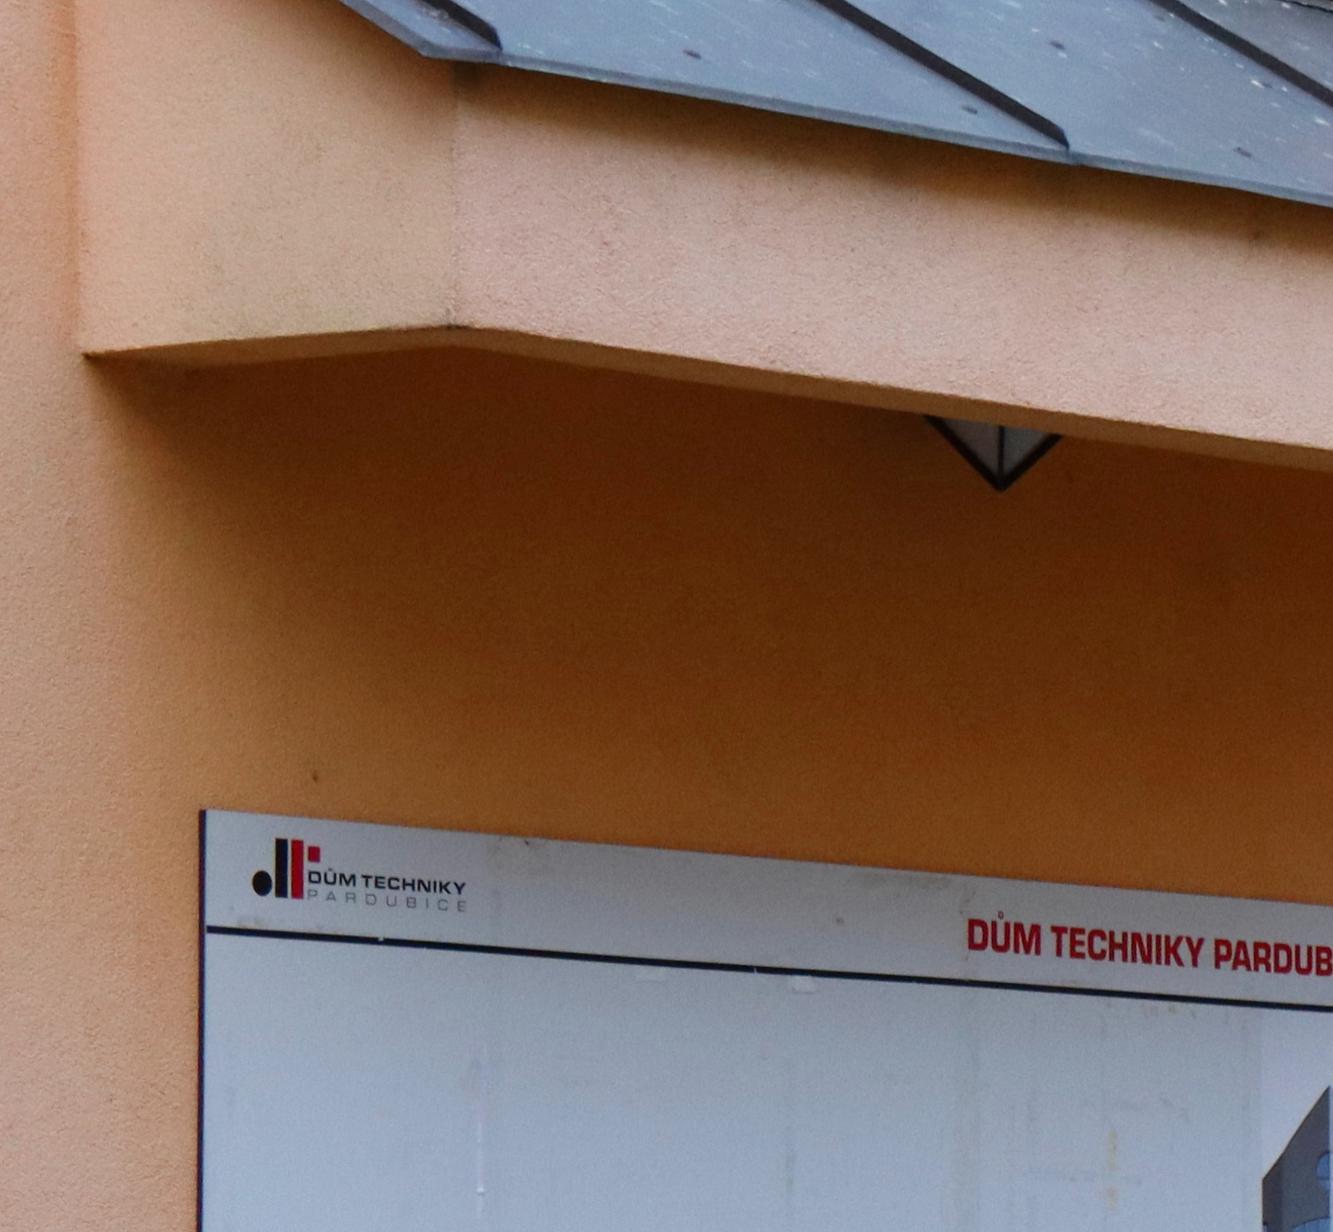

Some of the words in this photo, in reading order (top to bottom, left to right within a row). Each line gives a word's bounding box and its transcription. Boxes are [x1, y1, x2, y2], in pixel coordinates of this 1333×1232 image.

[308, 867, 357, 888] DŮM
[361, 874, 466, 896] TECHNIKY
[307, 888, 467, 913] PARDUBICE
[966, 910, 1041, 957] DŮM
[1051, 926, 1204, 969] TECHNIKY
